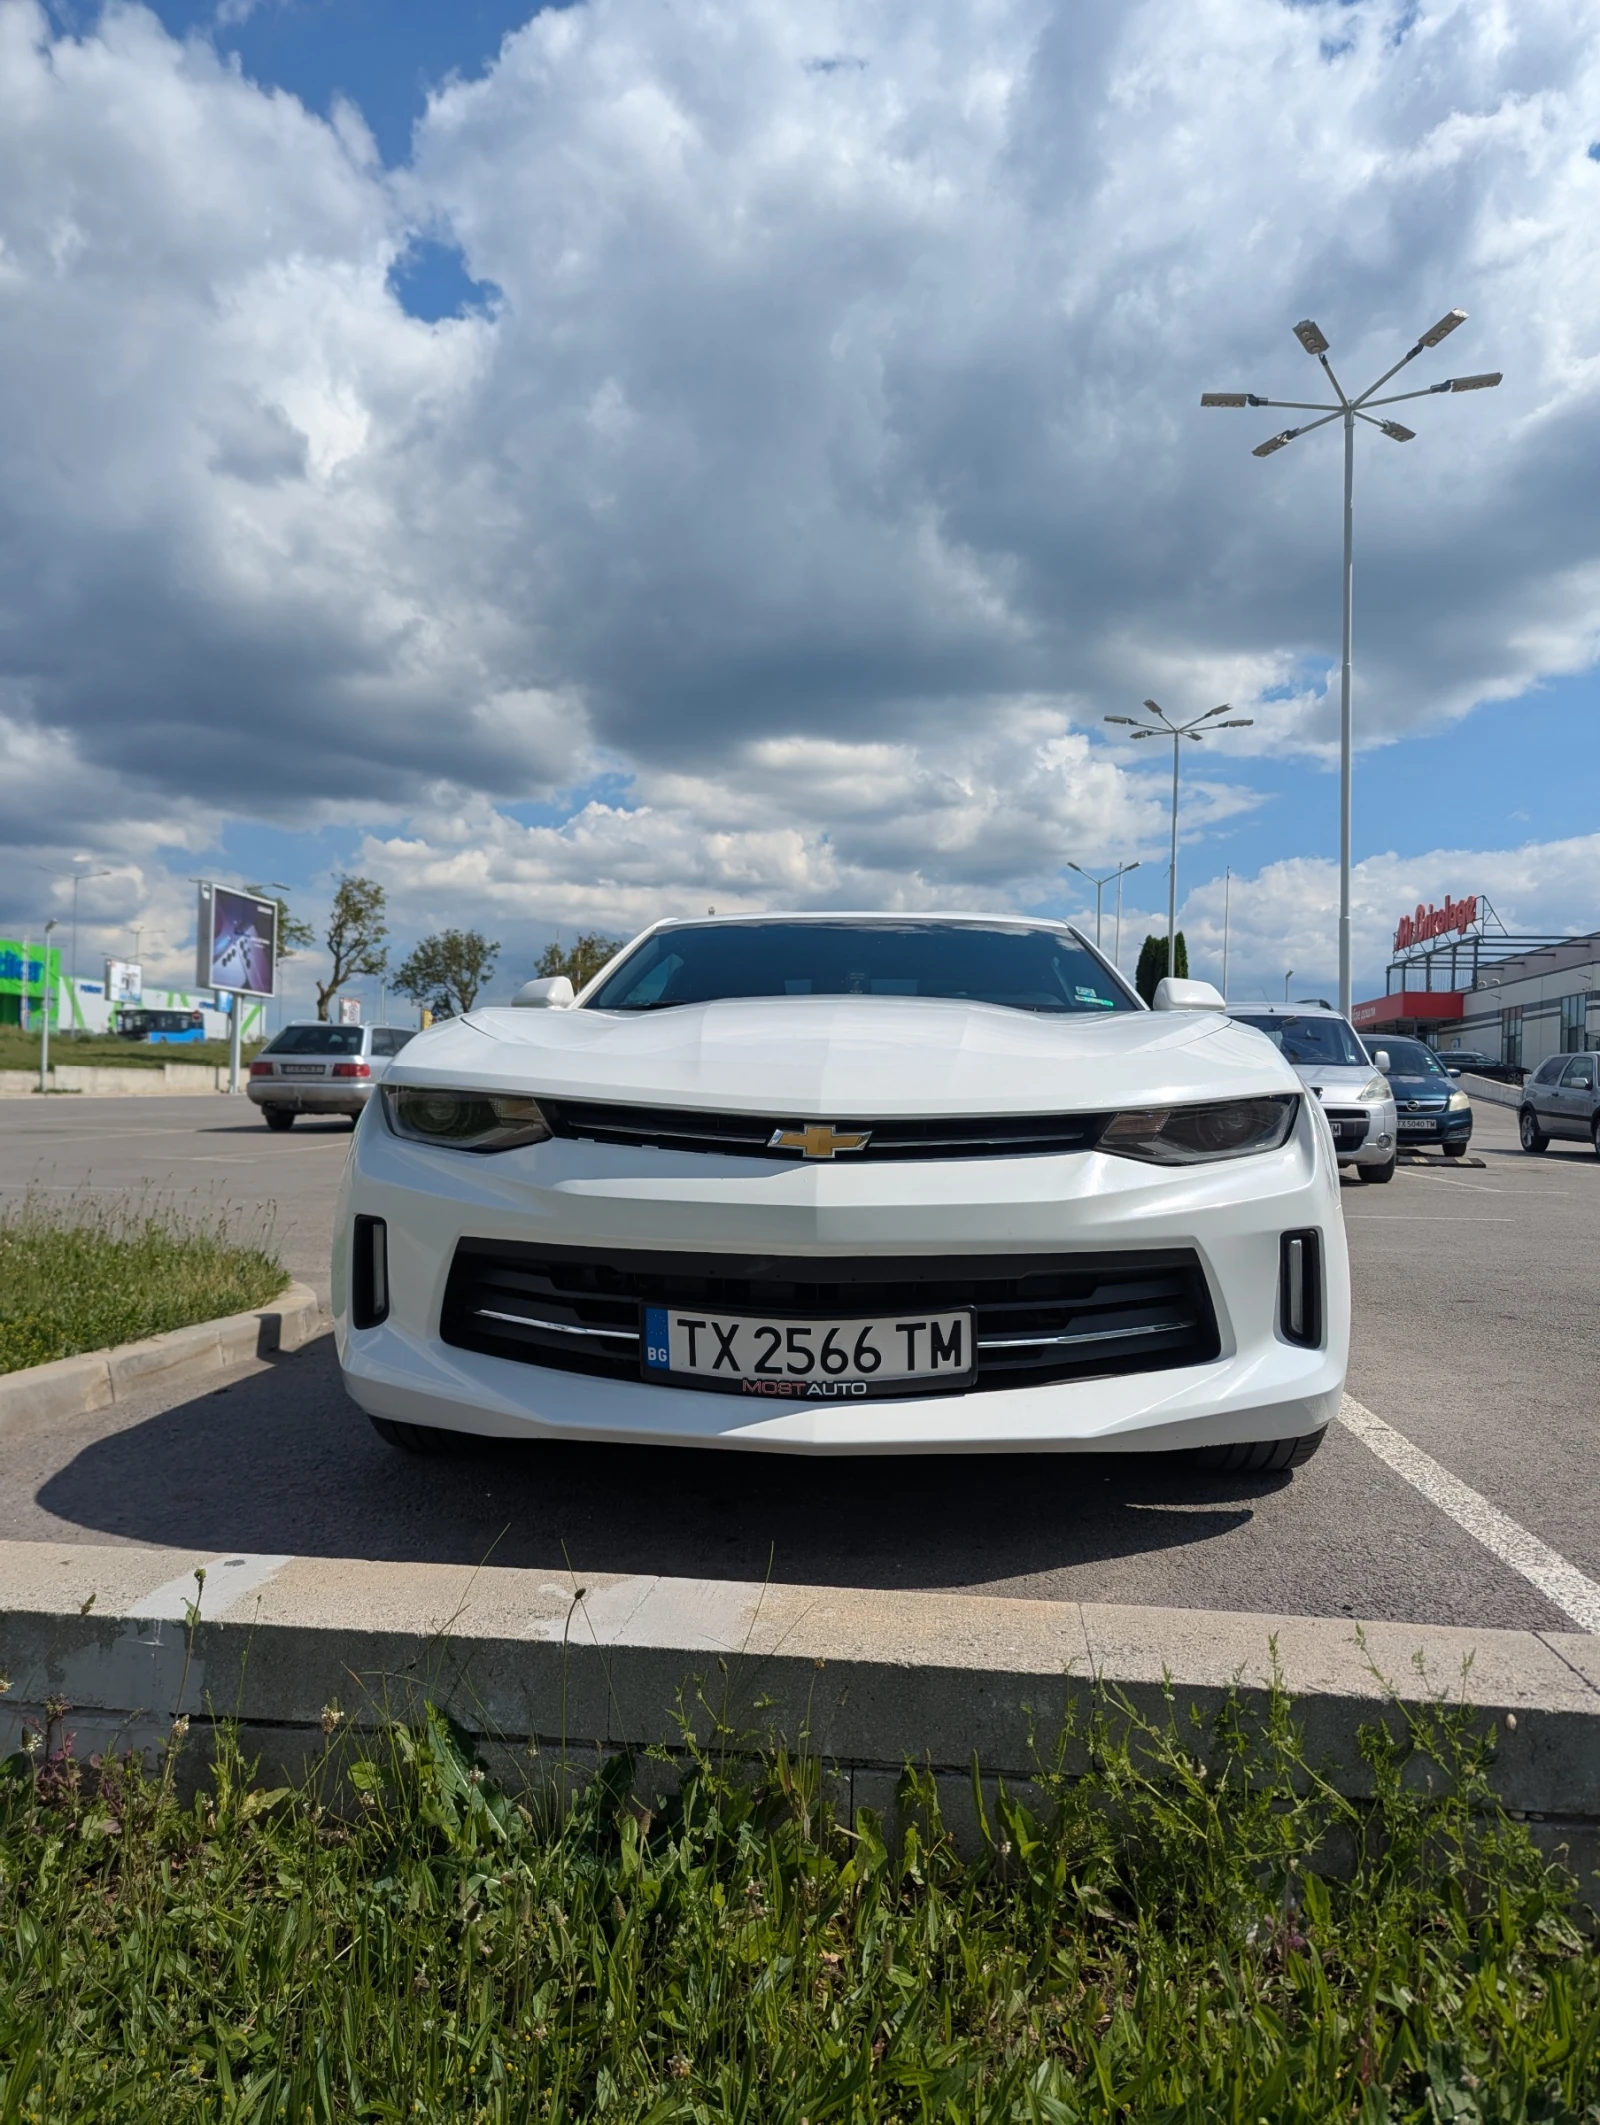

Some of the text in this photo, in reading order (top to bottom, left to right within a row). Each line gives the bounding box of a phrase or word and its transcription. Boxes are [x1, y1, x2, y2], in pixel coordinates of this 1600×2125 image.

[1414, 895, 1476, 943] Bricolage
[1426, 1120, 1435, 1128] TM
[647, 1347, 668, 1362] BG
[677, 1319, 962, 1375] TX 2566 TM
